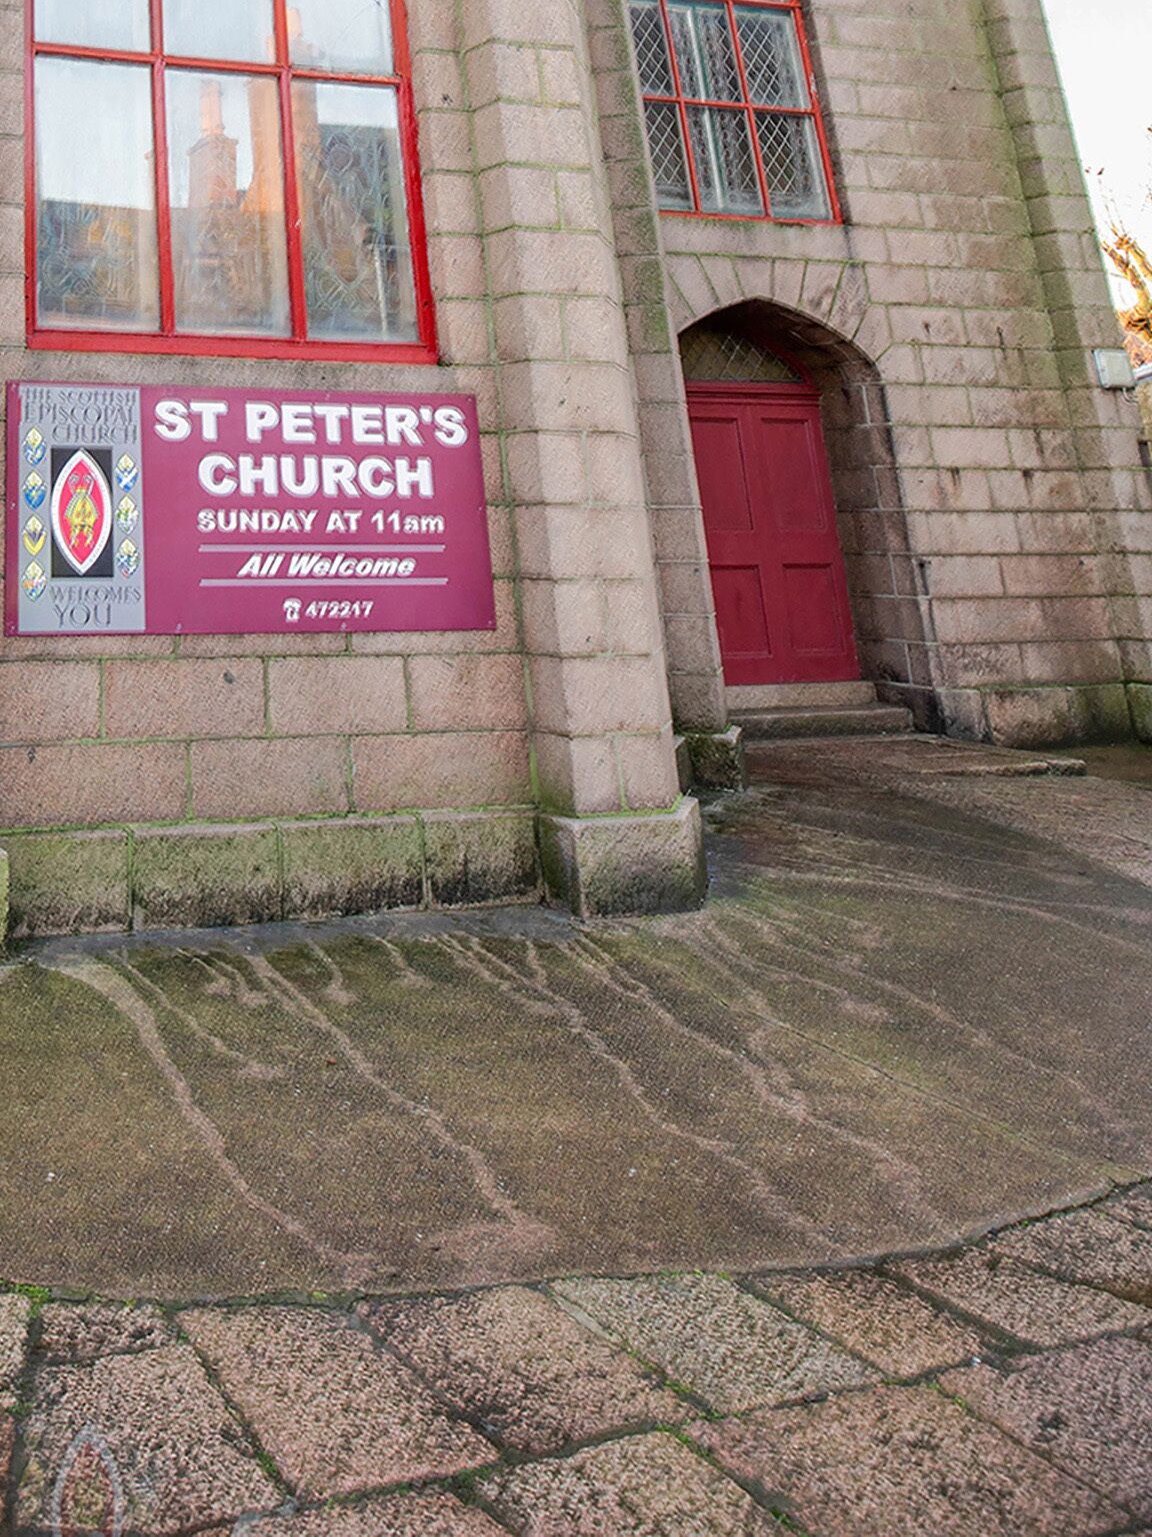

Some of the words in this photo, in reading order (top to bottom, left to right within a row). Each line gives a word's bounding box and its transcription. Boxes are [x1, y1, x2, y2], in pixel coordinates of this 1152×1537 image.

[23, 387, 51, 402] THE
[58, 389, 137, 405] SCOTTISH
[23, 403, 134, 425] EPISCOPAL
[153, 399, 229, 443] ST
[245, 400, 470, 448] PETER'S
[51, 424, 137, 445] CHURCH
[198, 452, 436, 499] CHURCH
[197, 508, 319, 534] SUNDAY
[324, 509, 363, 534] AT
[370, 510, 446, 534] 11am
[236, 552, 285, 578] All
[286, 552, 418, 578] Welcome
[50, 585, 142, 604] WELCOMES
[52, 602, 112, 629] YOU
